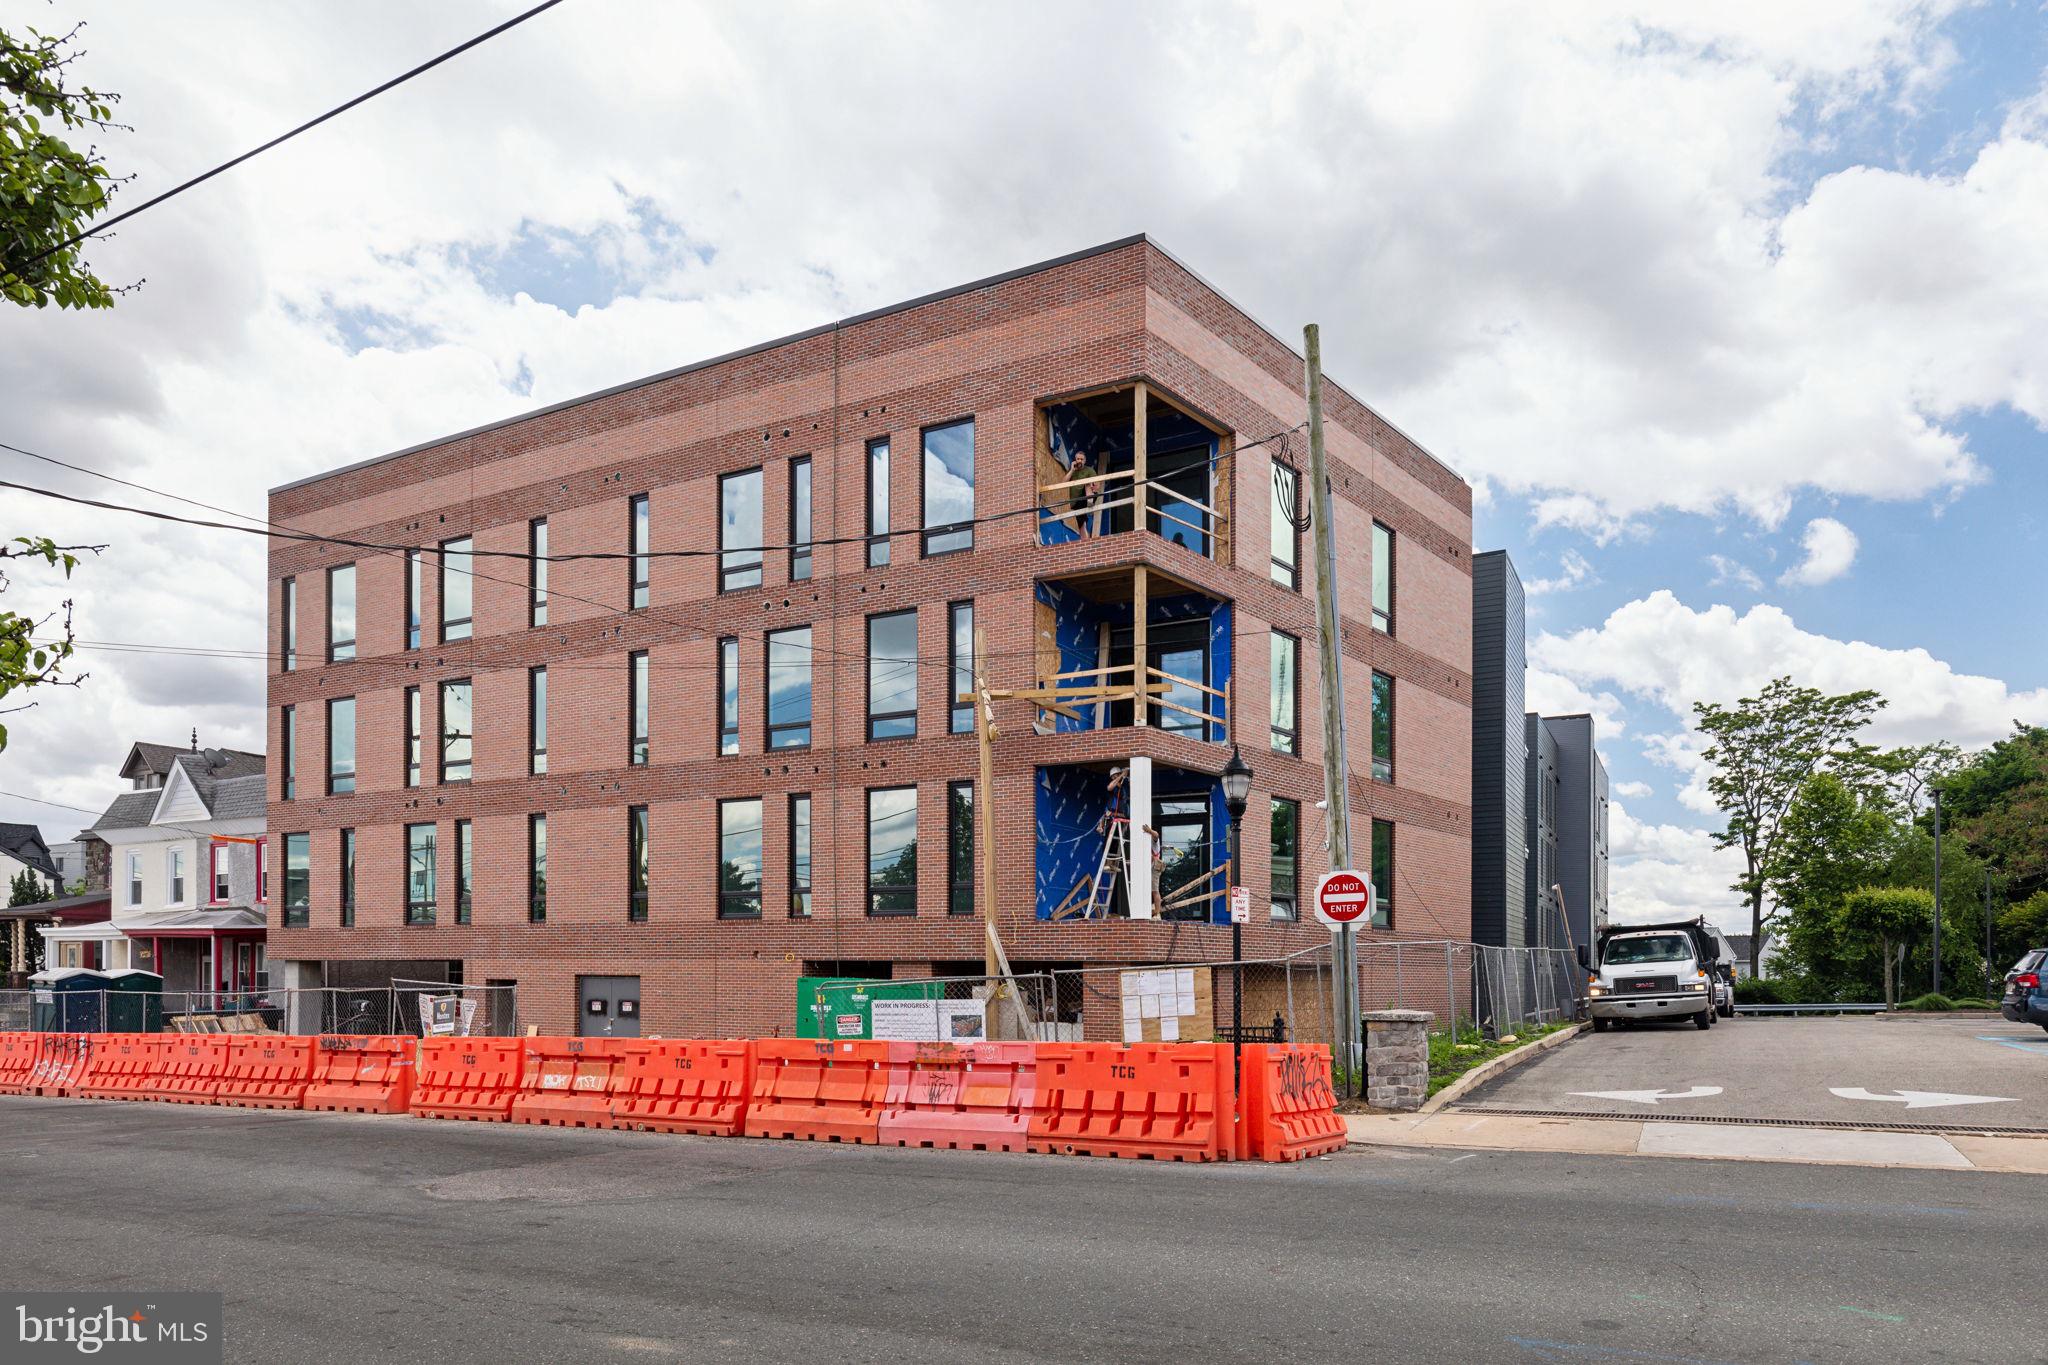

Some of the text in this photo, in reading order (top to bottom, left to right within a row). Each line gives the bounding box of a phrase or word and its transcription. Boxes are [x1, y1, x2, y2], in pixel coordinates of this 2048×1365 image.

[1328, 882, 1360, 892] DO NOT
[1330, 904, 1358, 913] ENTER
[121, 1046, 131, 1054] TCG
[189, 1047, 199, 1055] TCG
[263, 1050, 275, 1058] TCG
[462, 1055, 476, 1064] TCG
[675, 1058, 691, 1069] TCG
[1110, 1065, 1136, 1079] TCG
